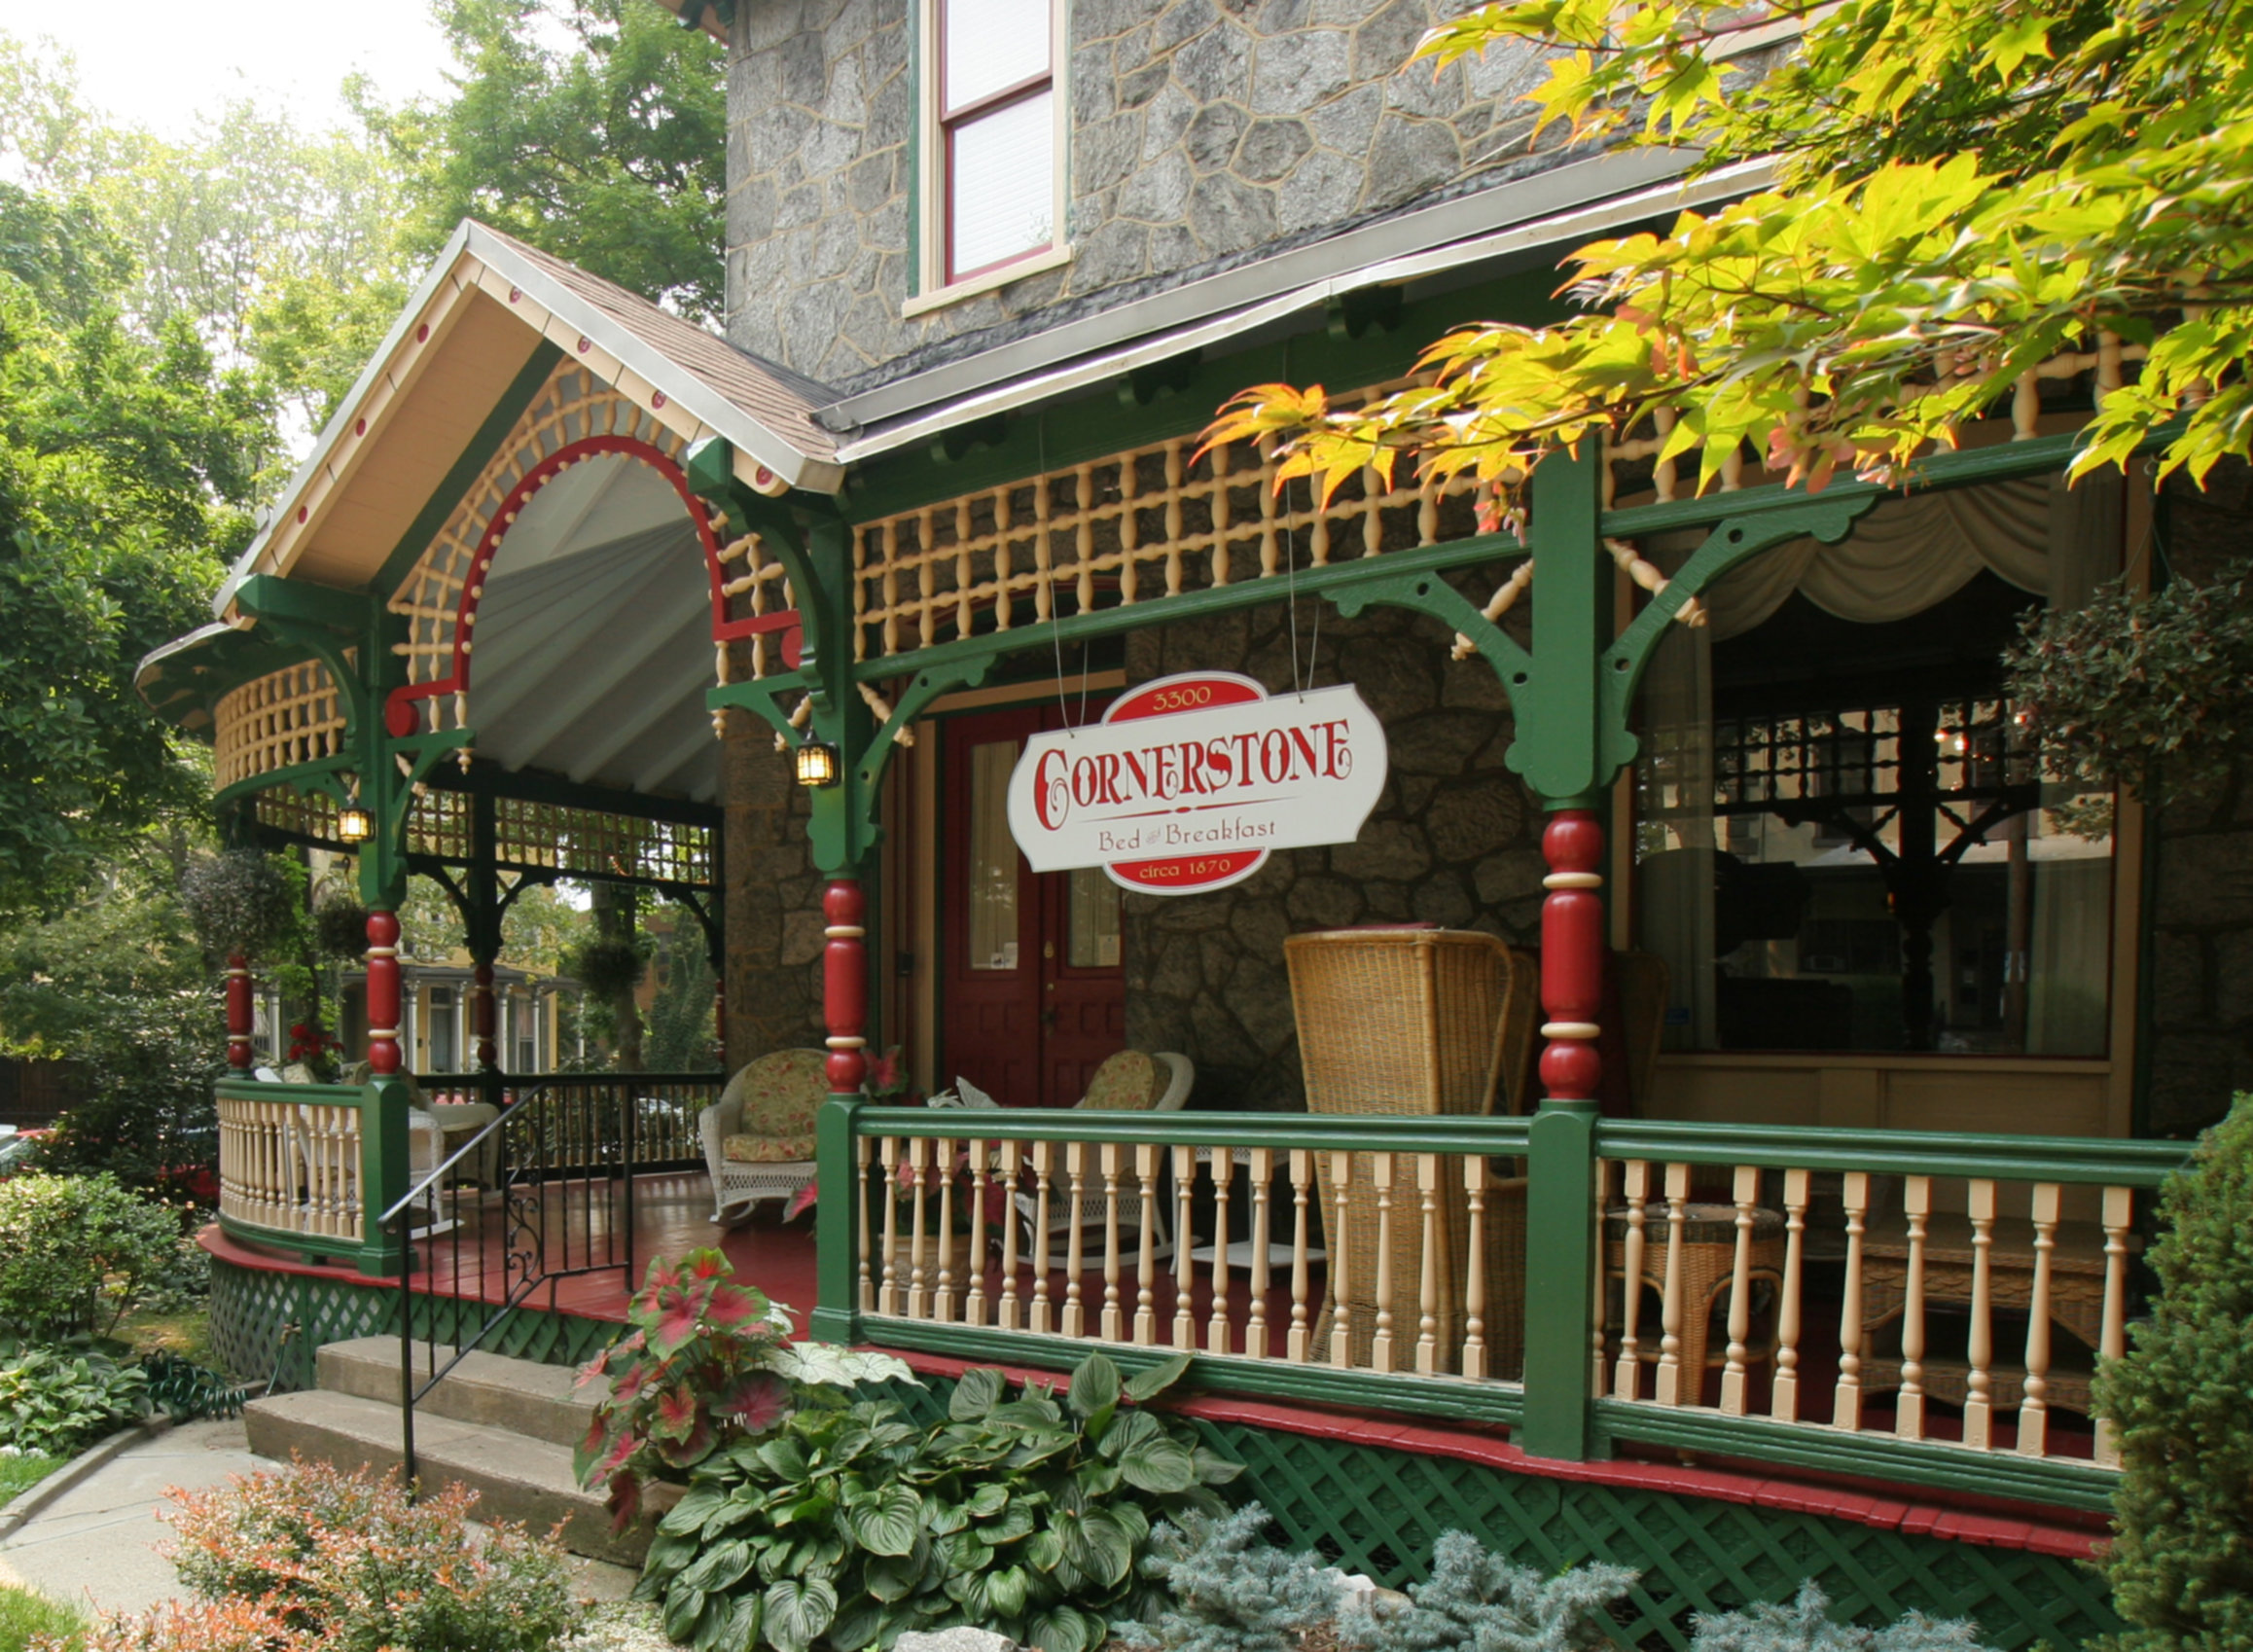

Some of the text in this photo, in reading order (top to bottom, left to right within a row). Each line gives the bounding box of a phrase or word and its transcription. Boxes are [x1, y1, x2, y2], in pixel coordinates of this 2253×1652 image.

[1152, 686, 1211, 711] 3300
[1033, 719, 1353, 832] CORNERSTONE
[1098, 828, 1141, 852] Bed
[1165, 816, 1275, 845] Breakfast
[1139, 859, 1231, 880] circa 1870
